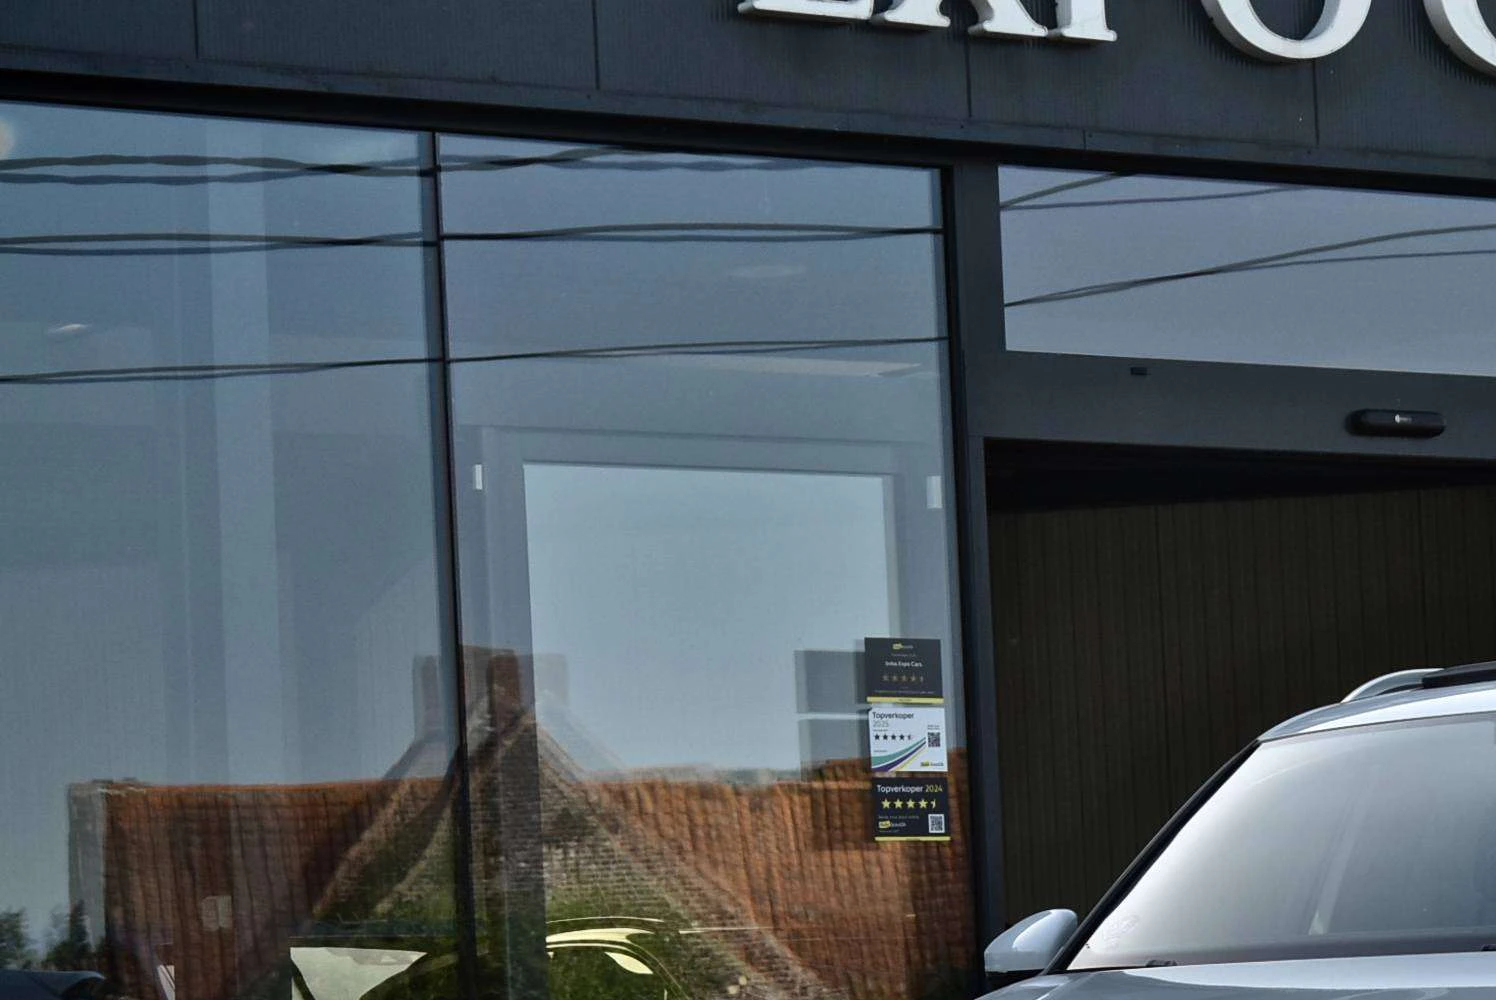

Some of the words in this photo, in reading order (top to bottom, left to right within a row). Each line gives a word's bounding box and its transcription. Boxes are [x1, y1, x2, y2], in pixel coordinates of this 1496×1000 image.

[872, 711, 914, 720] Topverkoper
[877, 784, 923, 795] Topverkoper
[925, 784, 943, 793] 2024
